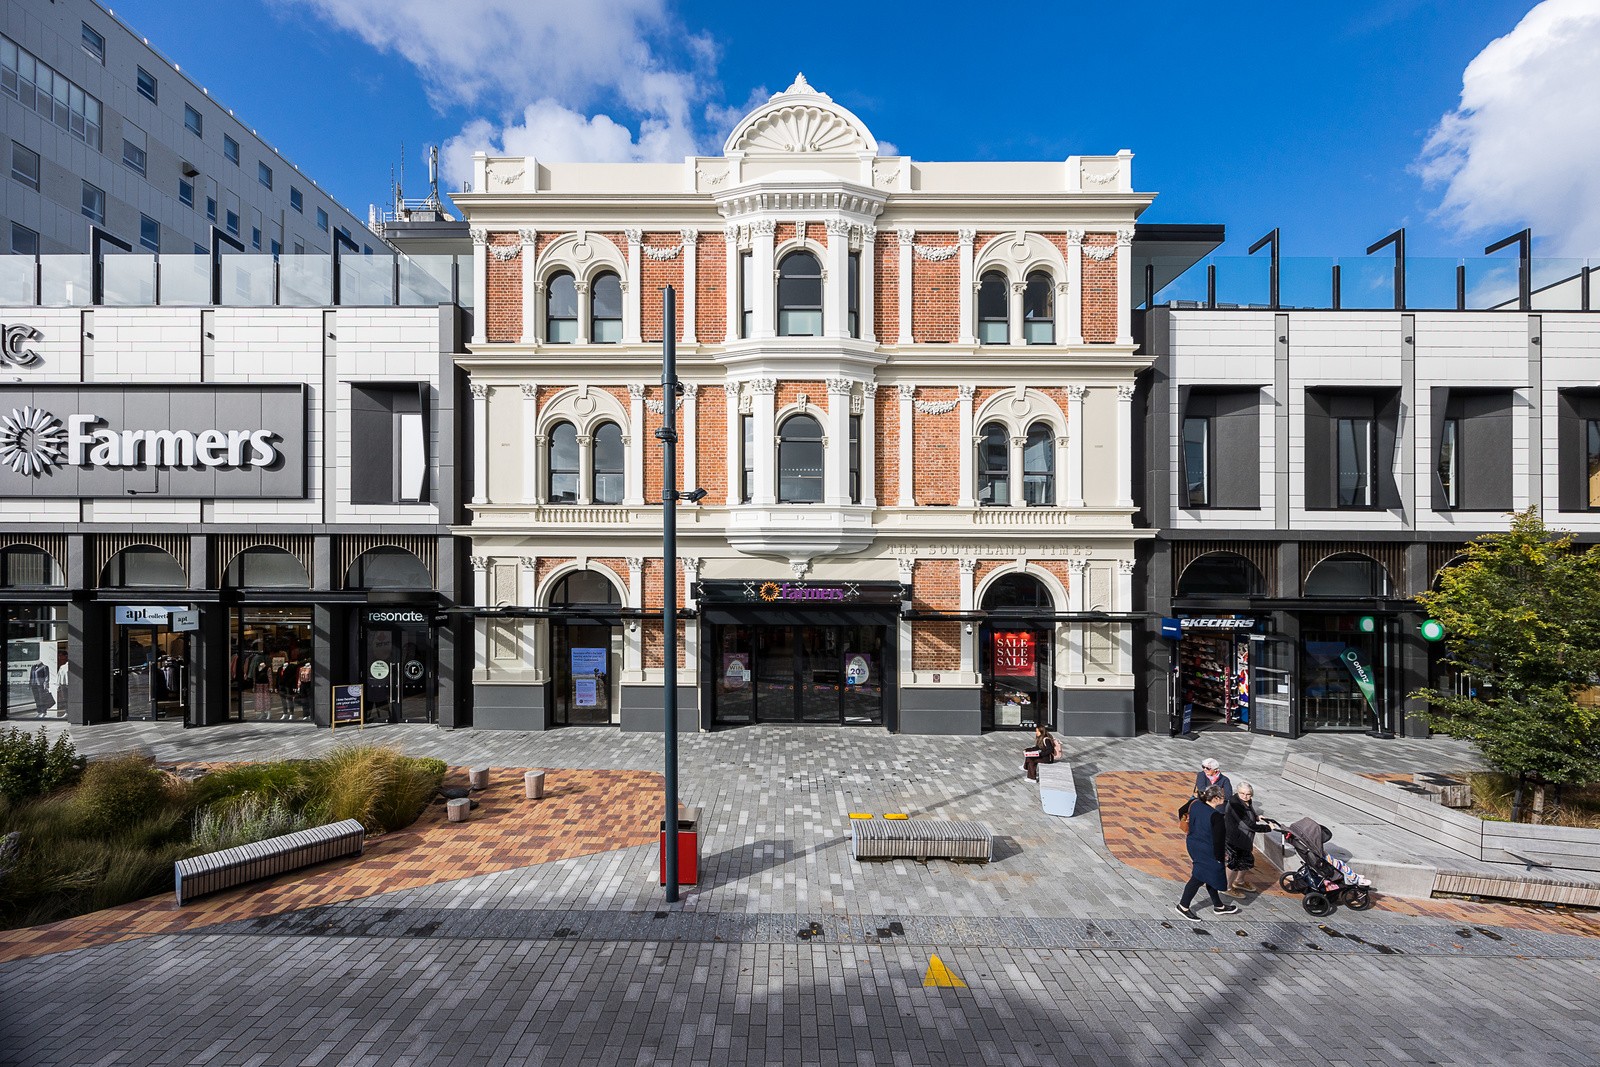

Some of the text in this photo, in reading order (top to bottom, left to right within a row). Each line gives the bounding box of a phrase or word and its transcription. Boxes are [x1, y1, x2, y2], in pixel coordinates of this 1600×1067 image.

[69, 414, 275, 466] Farmers
[887, 544, 1093, 556] THE SOUTHLAND TIMES
[782, 584, 844, 600] Farmers
[126, 608, 147, 622] apt
[1180, 618, 1256, 628] SKECHERS
[997, 638, 1028, 648] SALE
[997, 647, 1028, 657] SALE
[997, 657, 1028, 667] SALE
